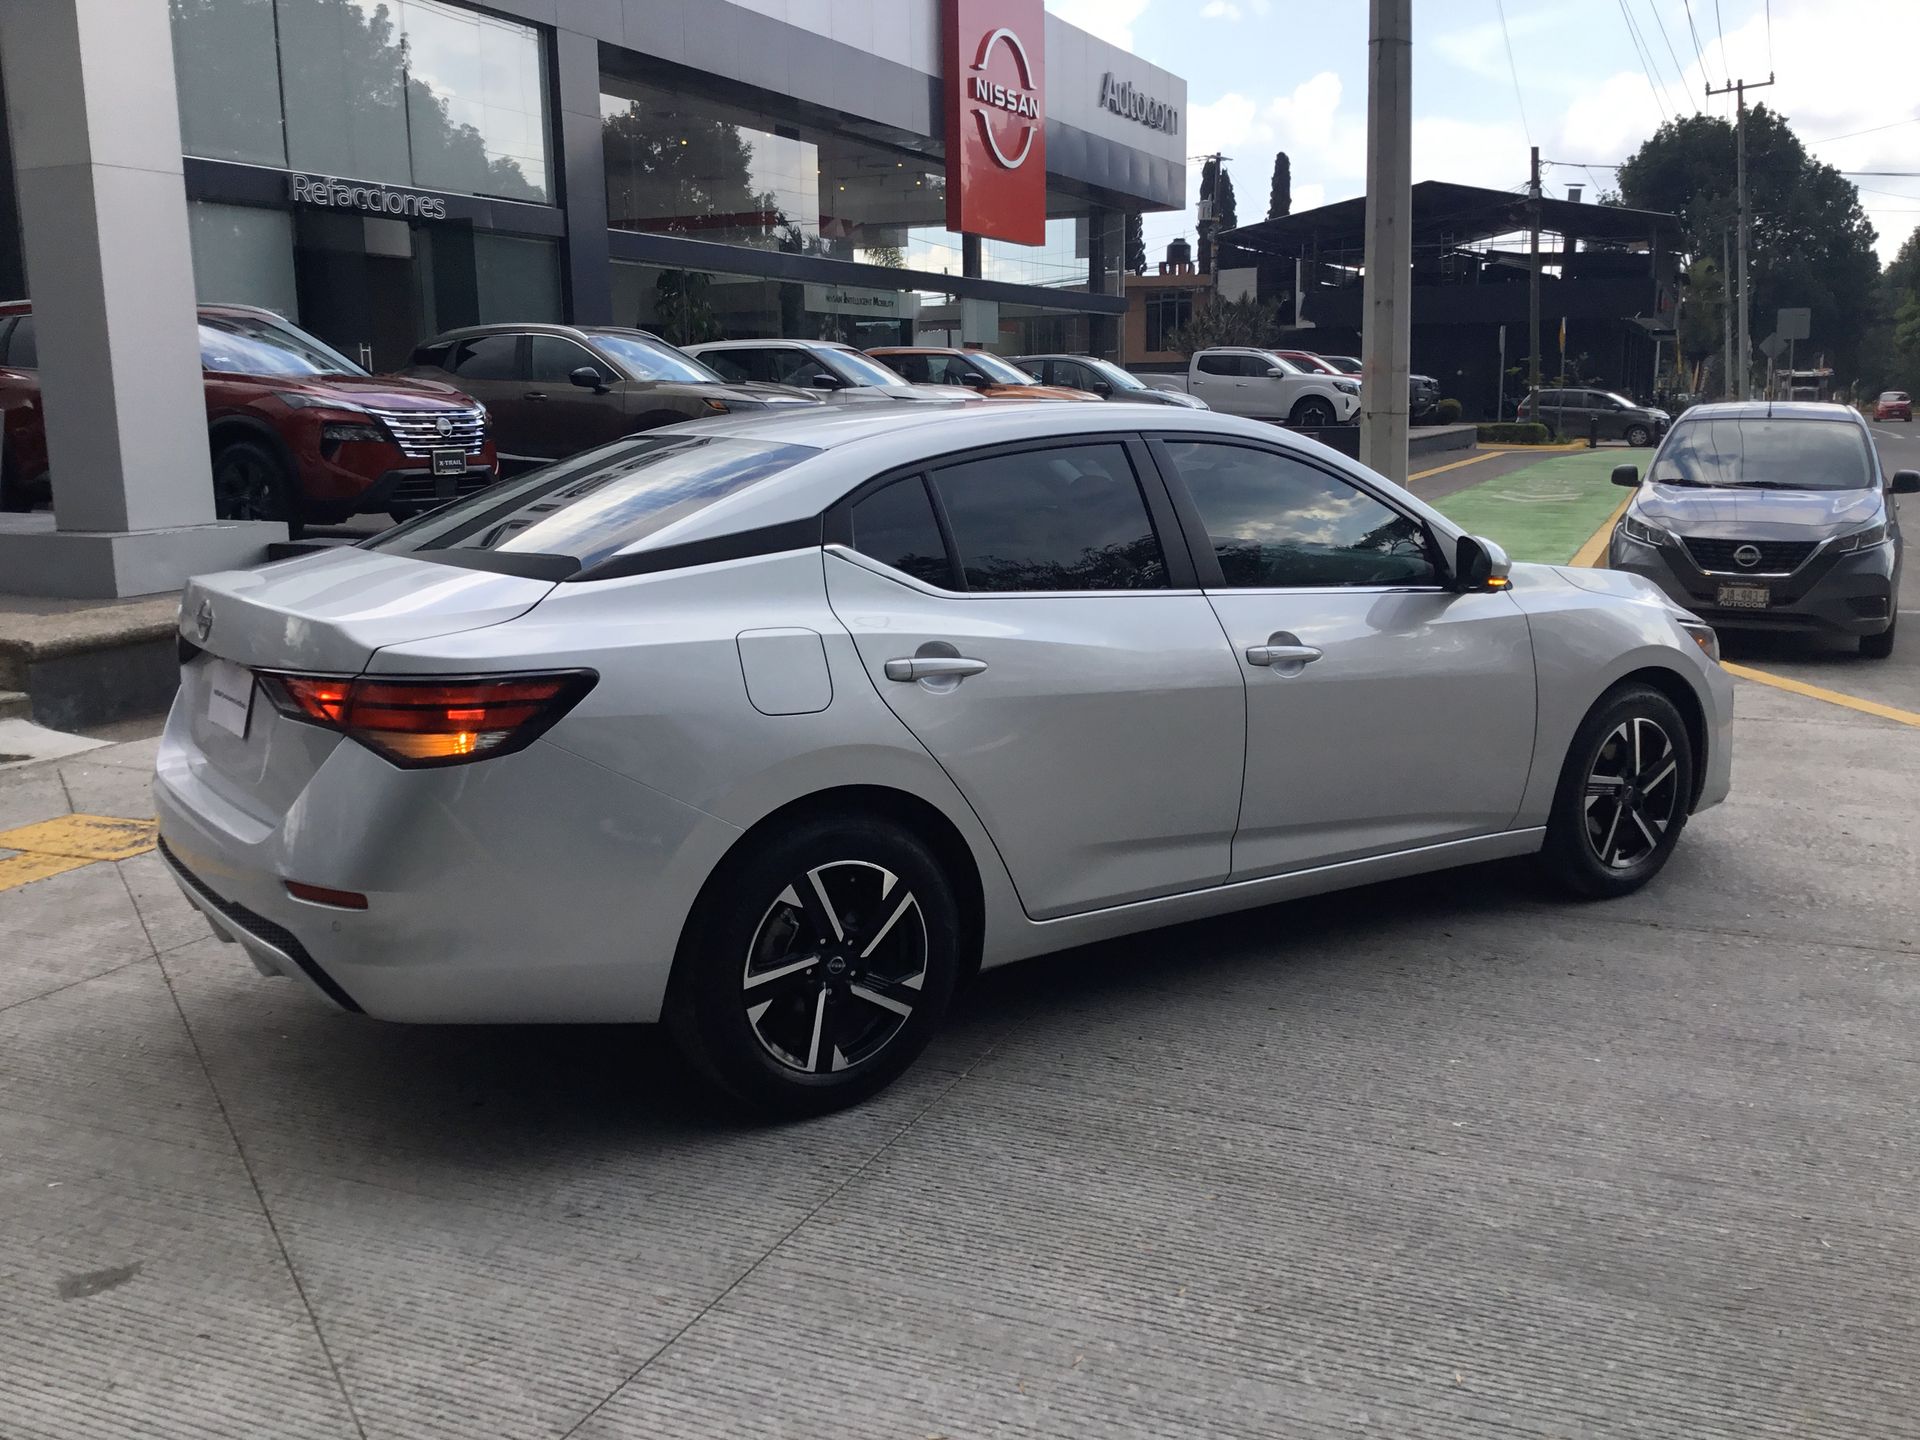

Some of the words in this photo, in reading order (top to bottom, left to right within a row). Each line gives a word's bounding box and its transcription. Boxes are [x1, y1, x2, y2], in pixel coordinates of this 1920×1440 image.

[975, 76, 1041, 119] NISSAN
[1098, 72, 1178, 136] Autocom
[292, 173, 447, 220] Refacciones
[1719, 601, 1766, 609] AUTOCOM
